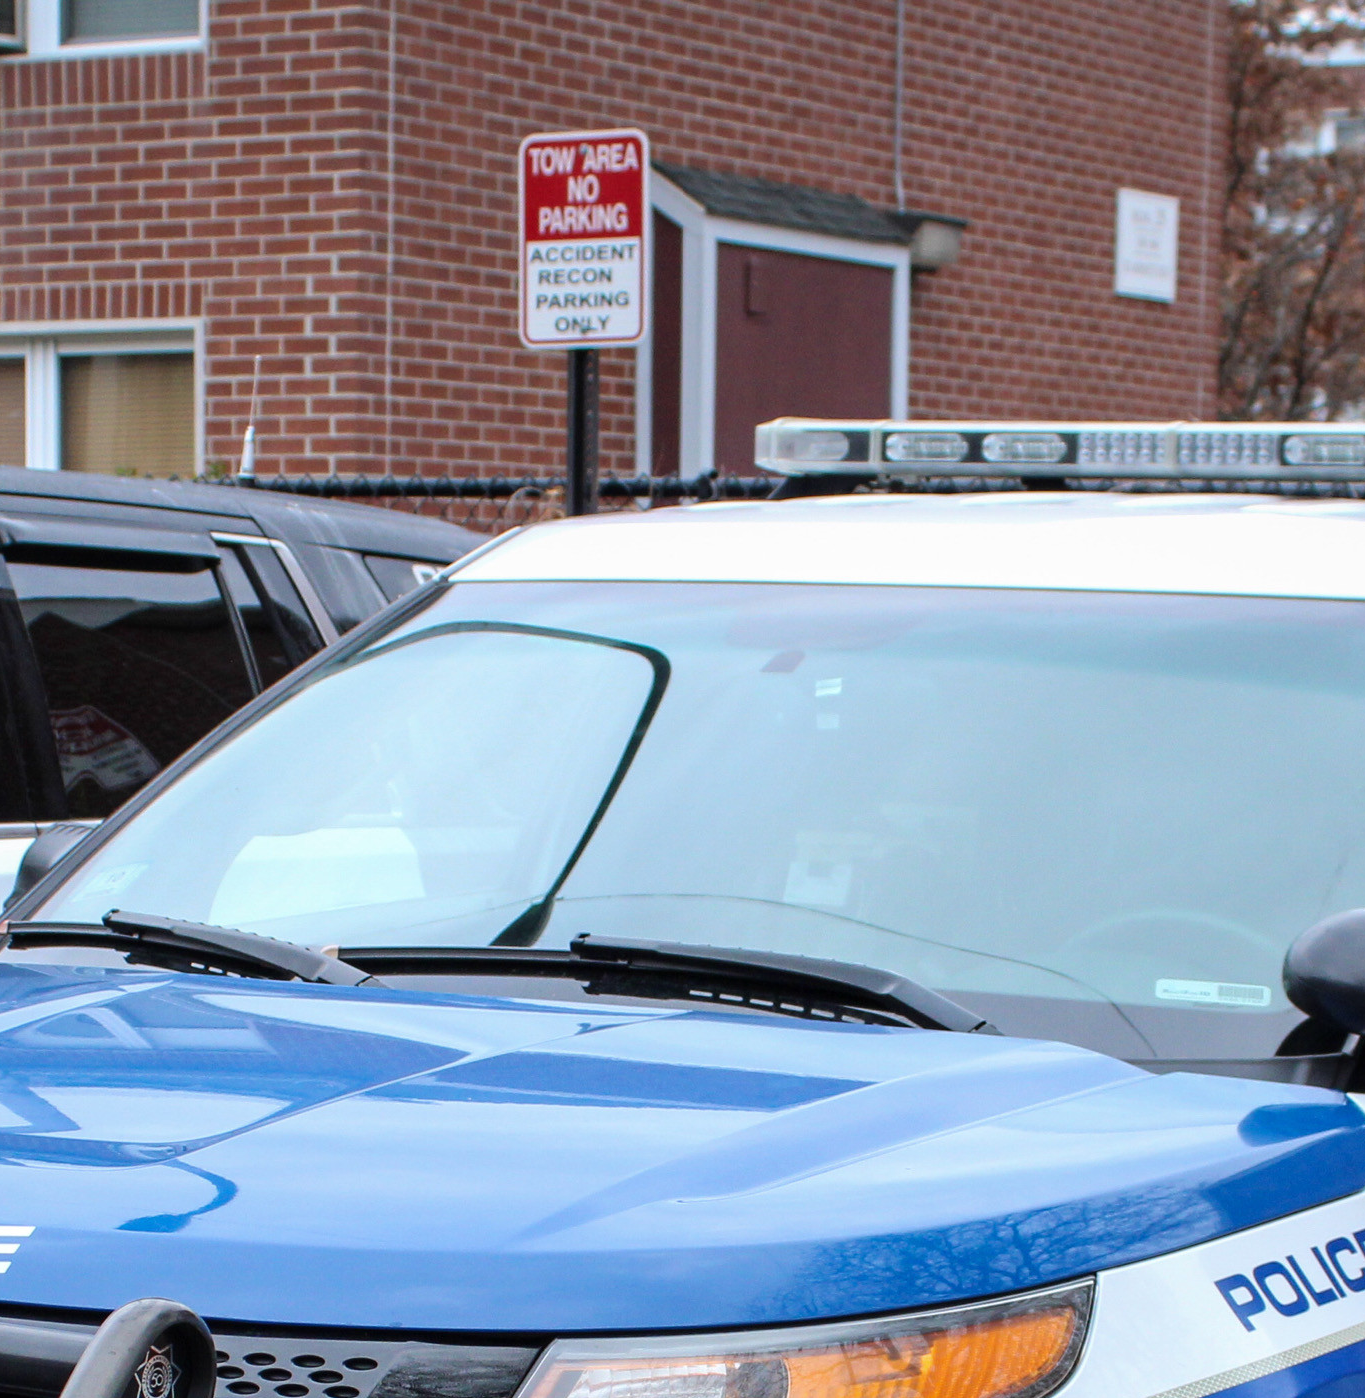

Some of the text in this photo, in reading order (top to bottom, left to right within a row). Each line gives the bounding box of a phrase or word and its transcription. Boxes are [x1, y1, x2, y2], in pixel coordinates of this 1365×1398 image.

[528, 142, 640, 176] TOW AREA
[567, 174, 600, 204] NO
[538, 202, 630, 235] PARKING
[530, 243, 637, 264] ACCIDENT
[538, 268, 613, 285] RECON
[536, 290, 630, 310] PARKING
[554, 315, 610, 333] ONLY
